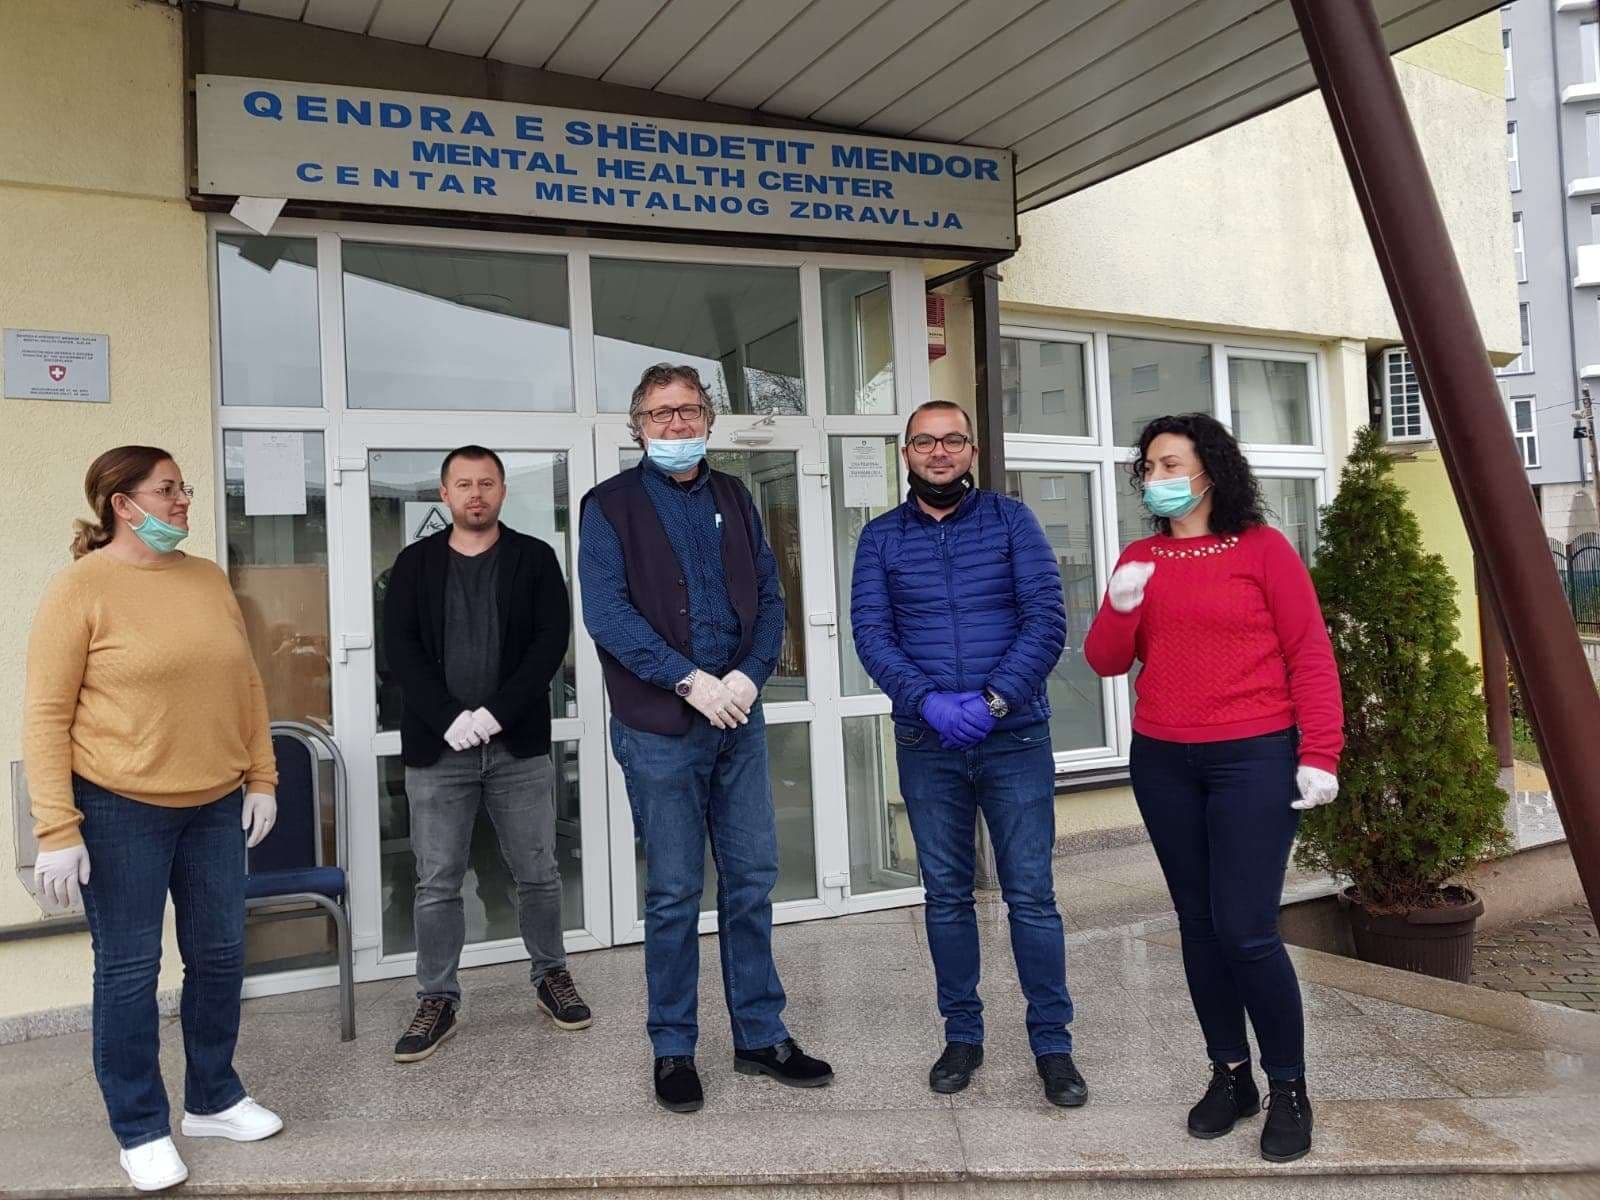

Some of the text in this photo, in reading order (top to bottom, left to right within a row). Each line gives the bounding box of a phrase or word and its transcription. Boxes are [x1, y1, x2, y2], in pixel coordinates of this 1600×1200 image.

[243, 91, 1000, 182] QENDRA E SHËNDETIT MENDOR
[412, 140, 895, 200] MENTAL HEALTH CENTER
[296, 163, 963, 230] CENTAR MENTALNOG ZDRAVLJA
